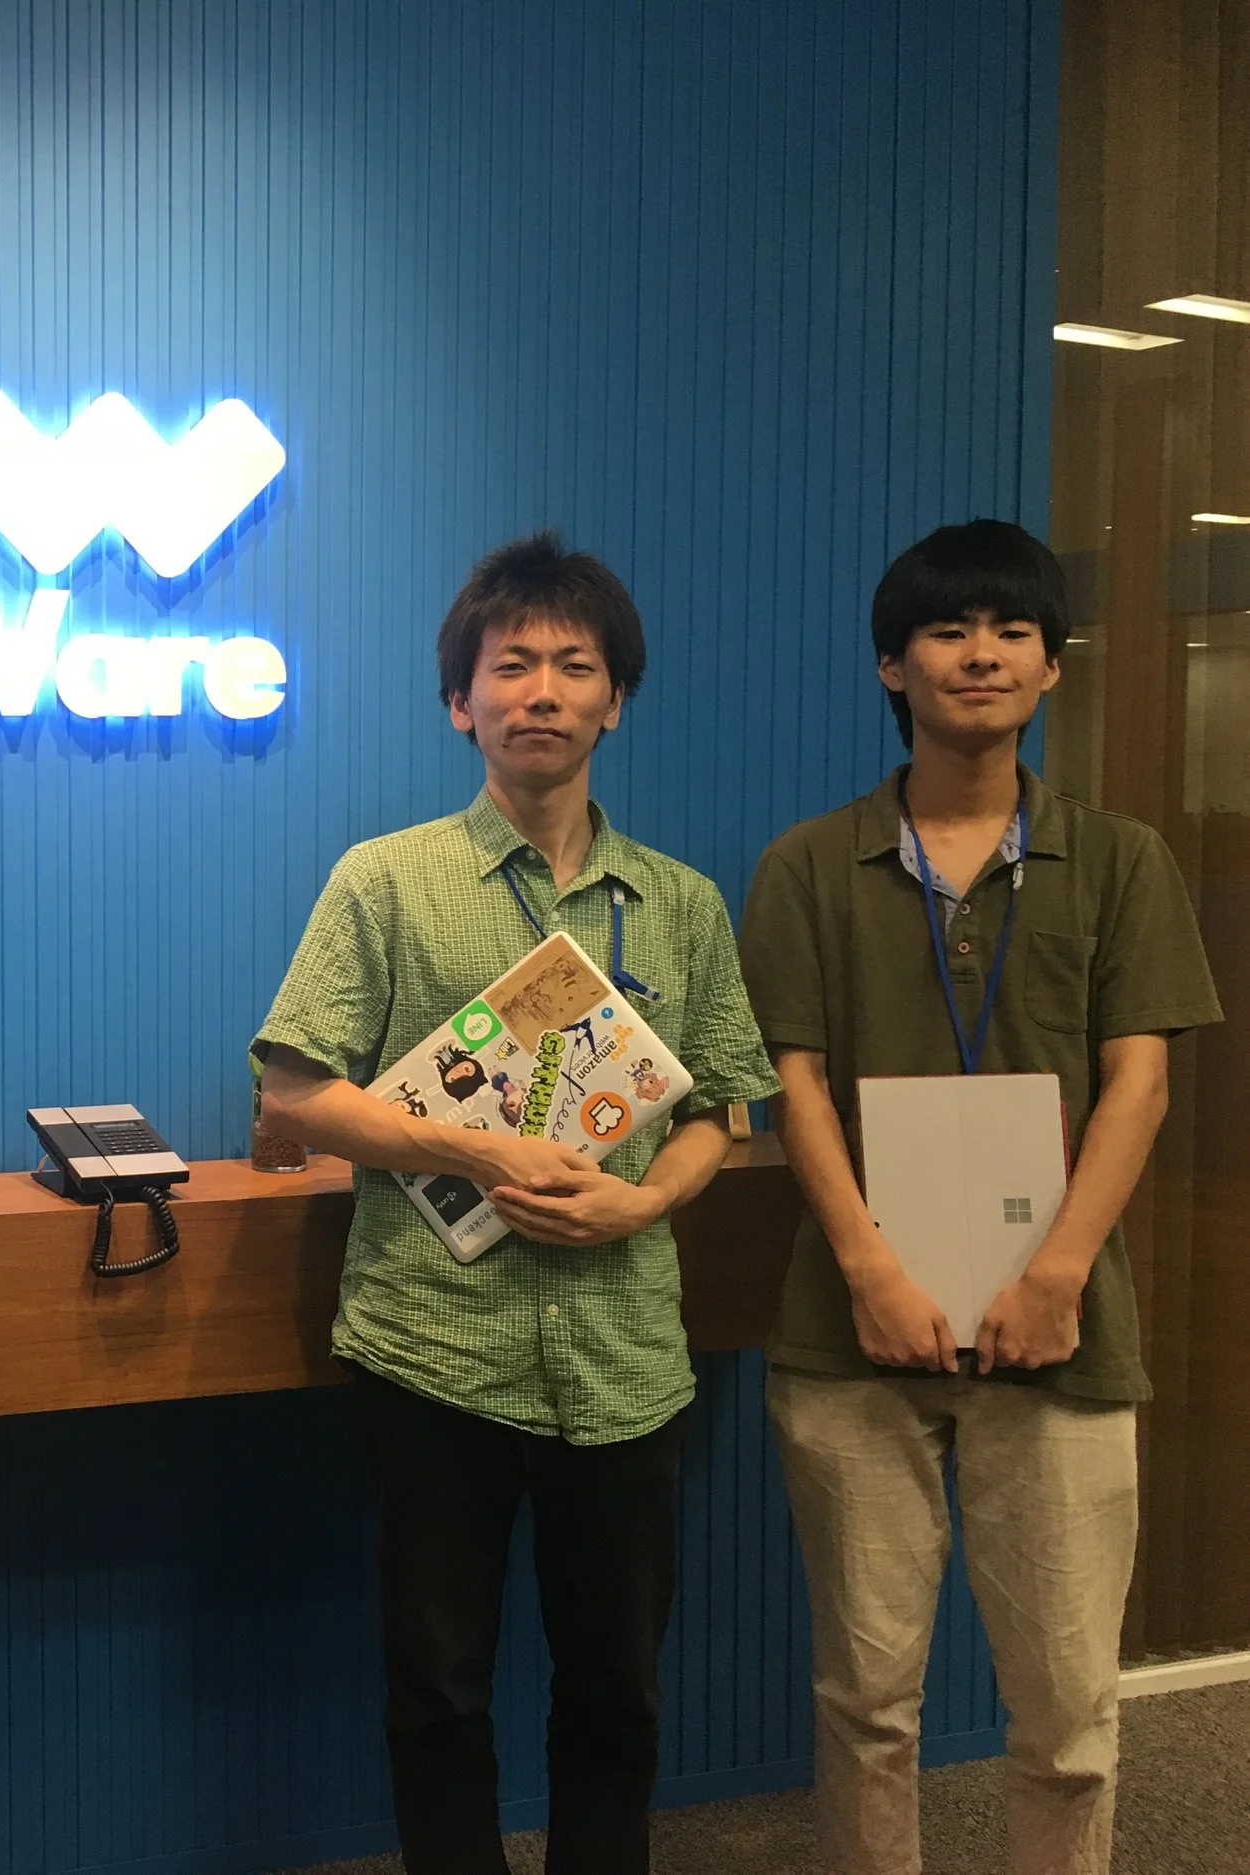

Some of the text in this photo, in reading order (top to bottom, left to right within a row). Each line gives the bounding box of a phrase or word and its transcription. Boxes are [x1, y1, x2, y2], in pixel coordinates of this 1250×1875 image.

[467, 1017, 489, 1036] LINE
[571, 1035, 610, 1073] web ervices
[576, 1040, 618, 1081] amazon
